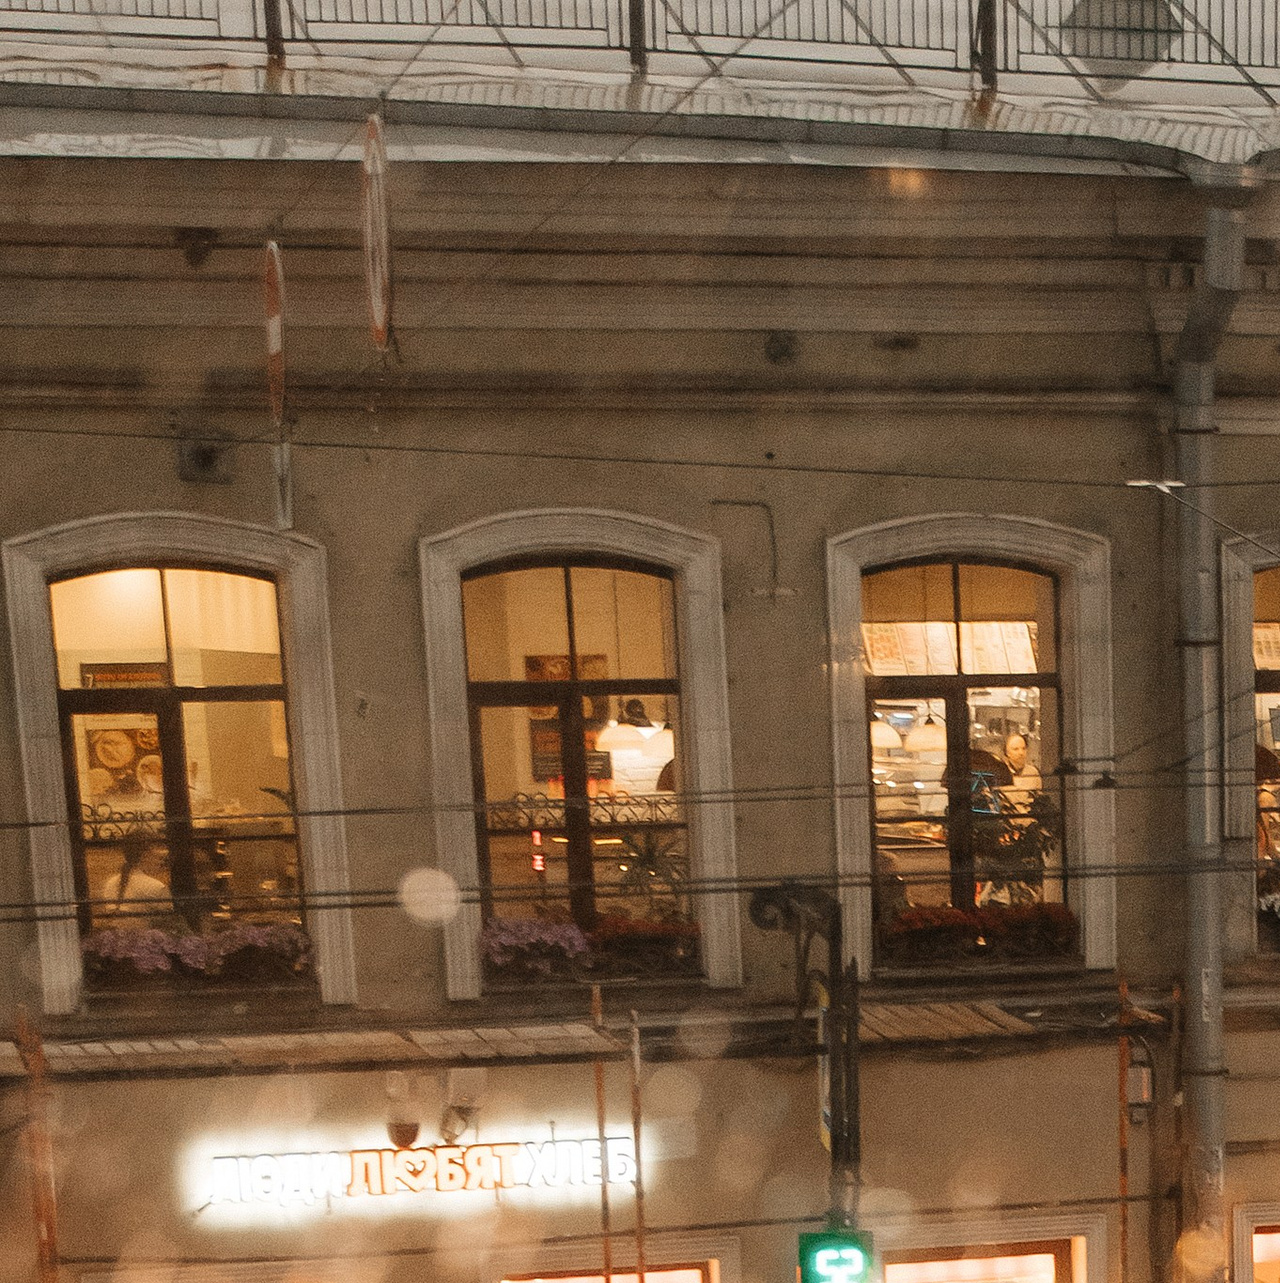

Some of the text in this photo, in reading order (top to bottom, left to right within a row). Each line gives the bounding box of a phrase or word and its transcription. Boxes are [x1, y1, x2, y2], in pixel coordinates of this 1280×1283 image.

[210, 1137, 637, 1207] ЛЮДИ ЛЮБЯТ ХЛЕБ
